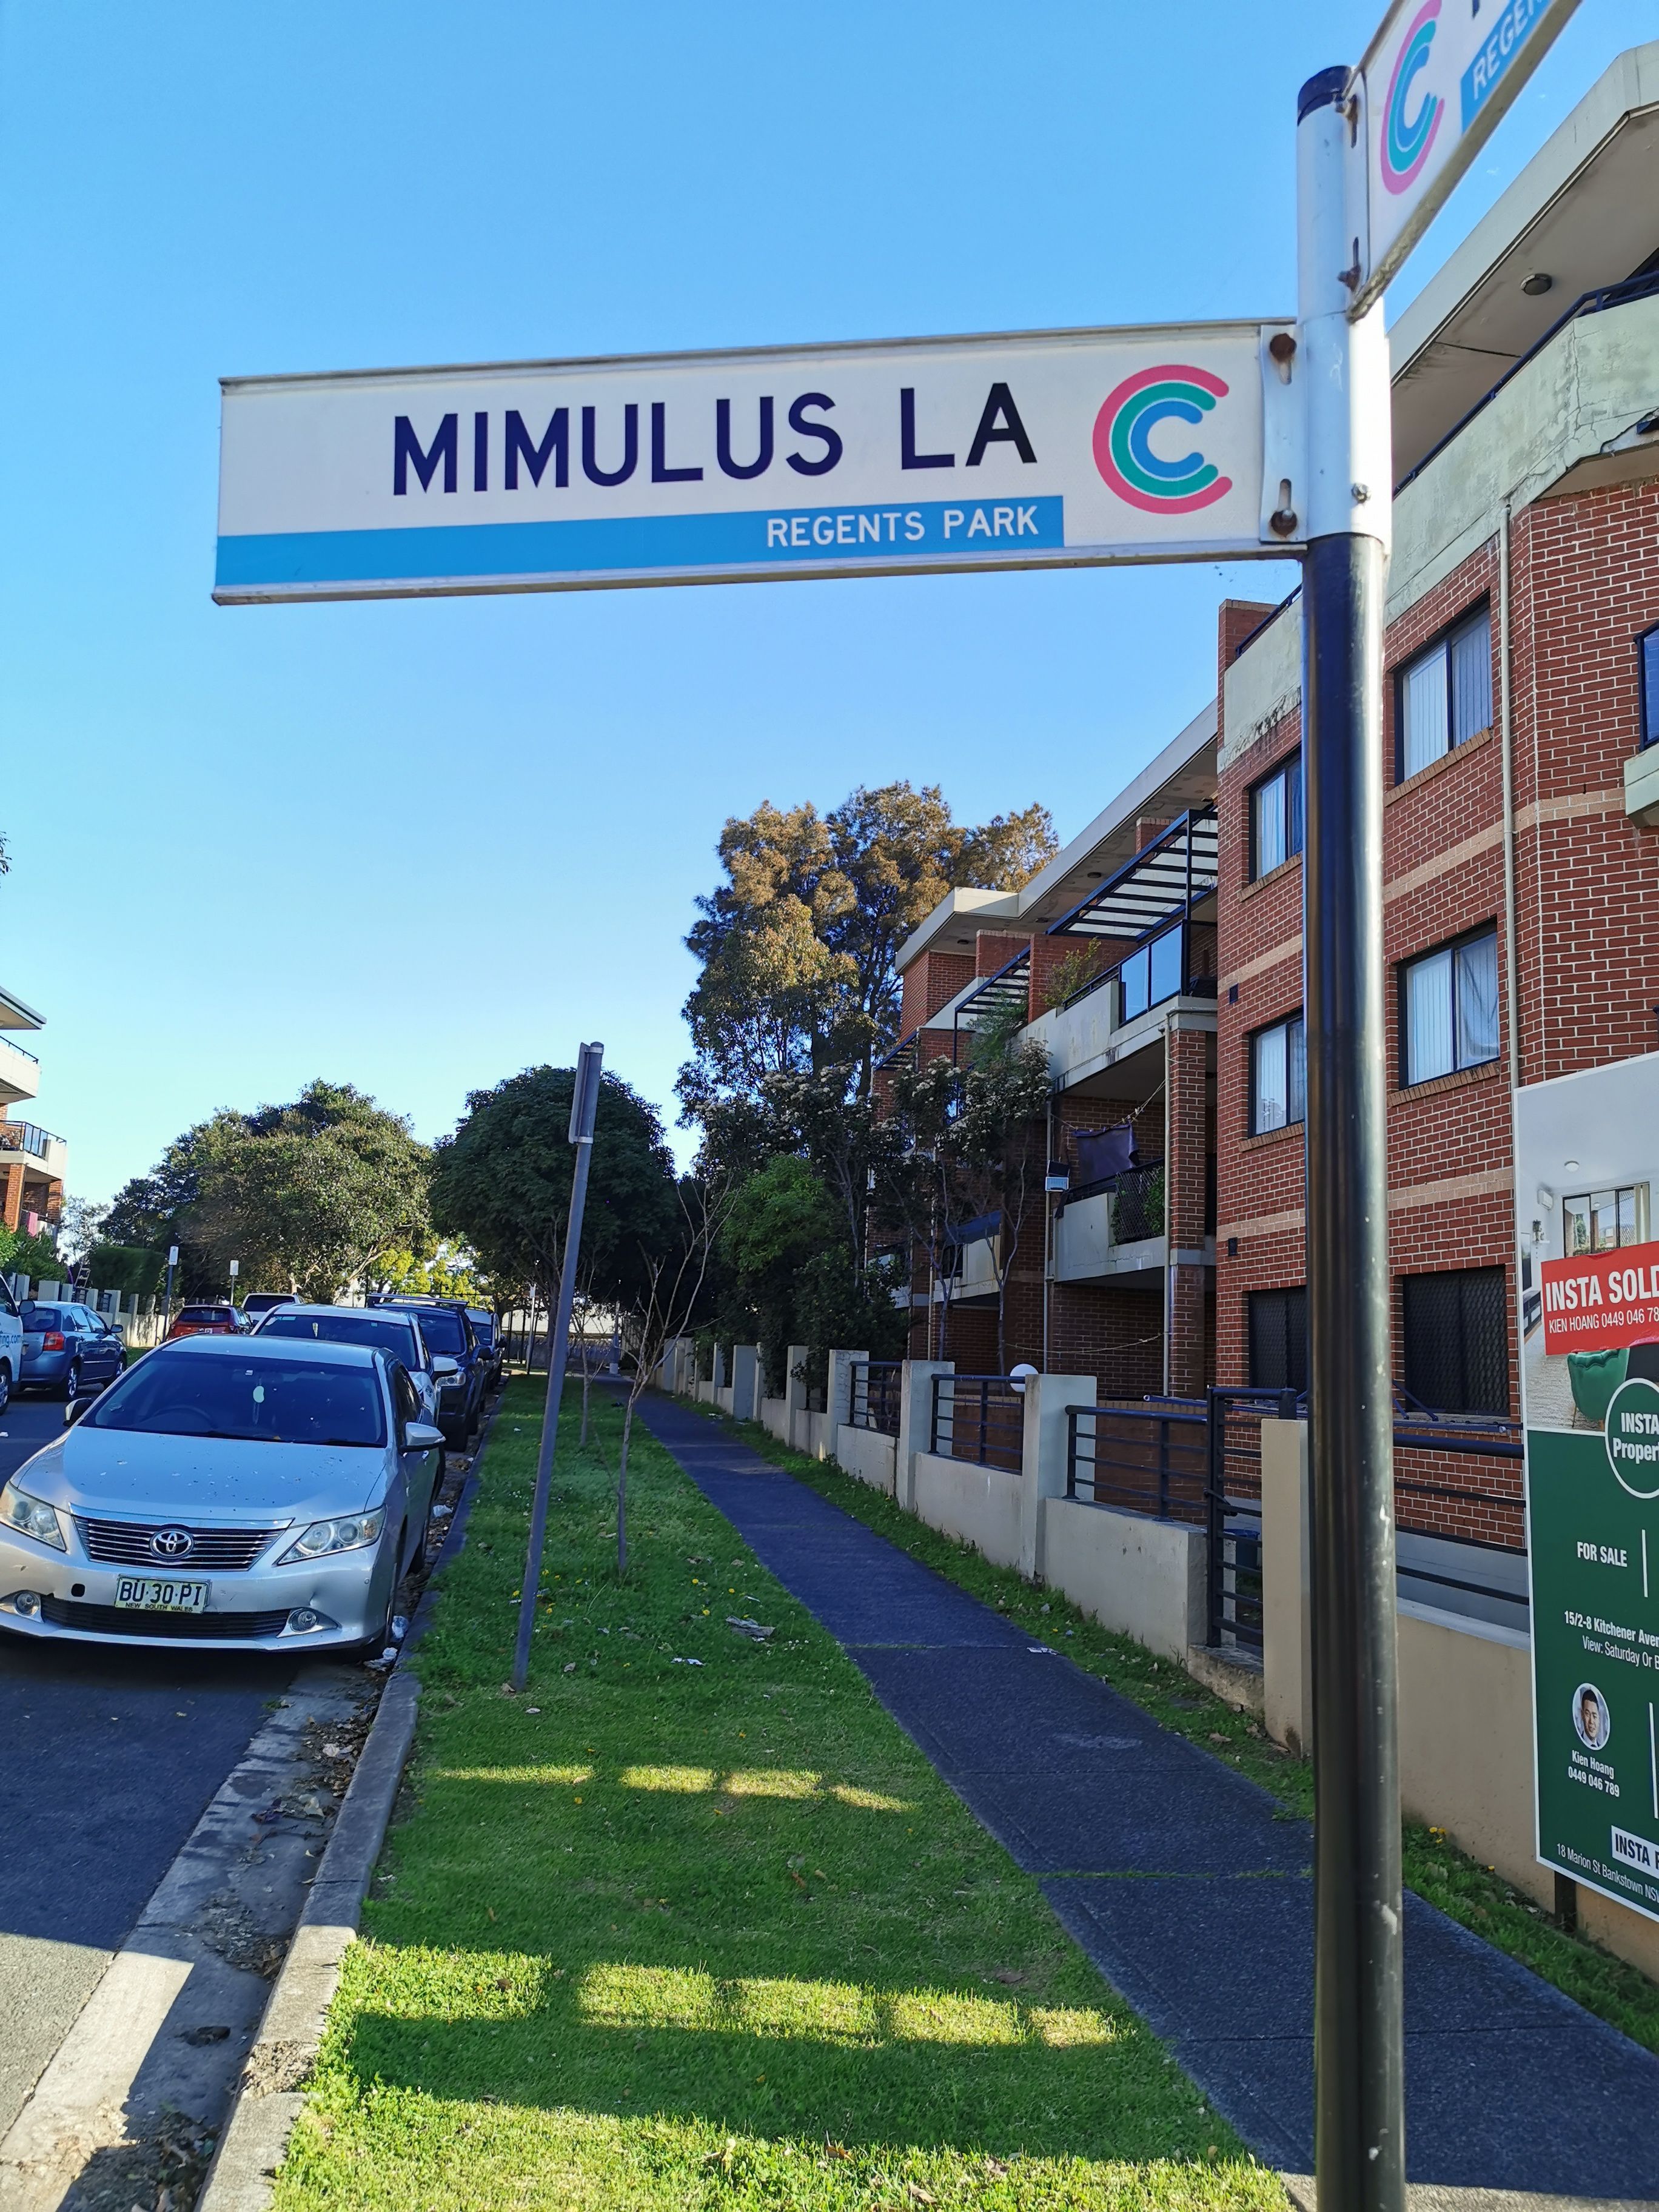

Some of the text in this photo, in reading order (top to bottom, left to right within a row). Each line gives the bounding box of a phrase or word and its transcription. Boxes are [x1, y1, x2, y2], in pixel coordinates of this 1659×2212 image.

[394, 383, 1038, 495] MIMULUS LA
[767, 505, 1039, 548] REGENTS PARK
[1545, 1275, 1604, 1312] INSTA
[1549, 1318, 1567, 1334] KIEN
[1569, 1313, 1599, 1332] HOANG
[1601, 1310, 1624, 1328] 0449
[1627, 1308, 1645, 1326] 046
[1621, 1412, 1659, 1435] INSTA
[1613, 1437, 1659, 1464] Proper
[1577, 1541, 1627, 1567] FOR SALE
[1564, 1610, 1592, 1630] 15/2-8
[1594, 1617, 1637, 1641] Kitchener
[1582, 1635, 1603, 1654] View:
[1604, 1641, 1640, 1667] Saturday
[1642, 1651, 1653, 1667] Or
[1572, 1749, 1614, 1780] Kien Hoang
[1568, 1766, 1620, 1797] 0449 046 789
[1615, 1833, 1651, 1866] INSTA
[1557, 1843, 1566, 1858] 18
[1567, 1847, 1591, 1871] Marion
[1592, 1859, 1601, 1875] St
[1602, 1863, 1643, 1896] Bankstown
